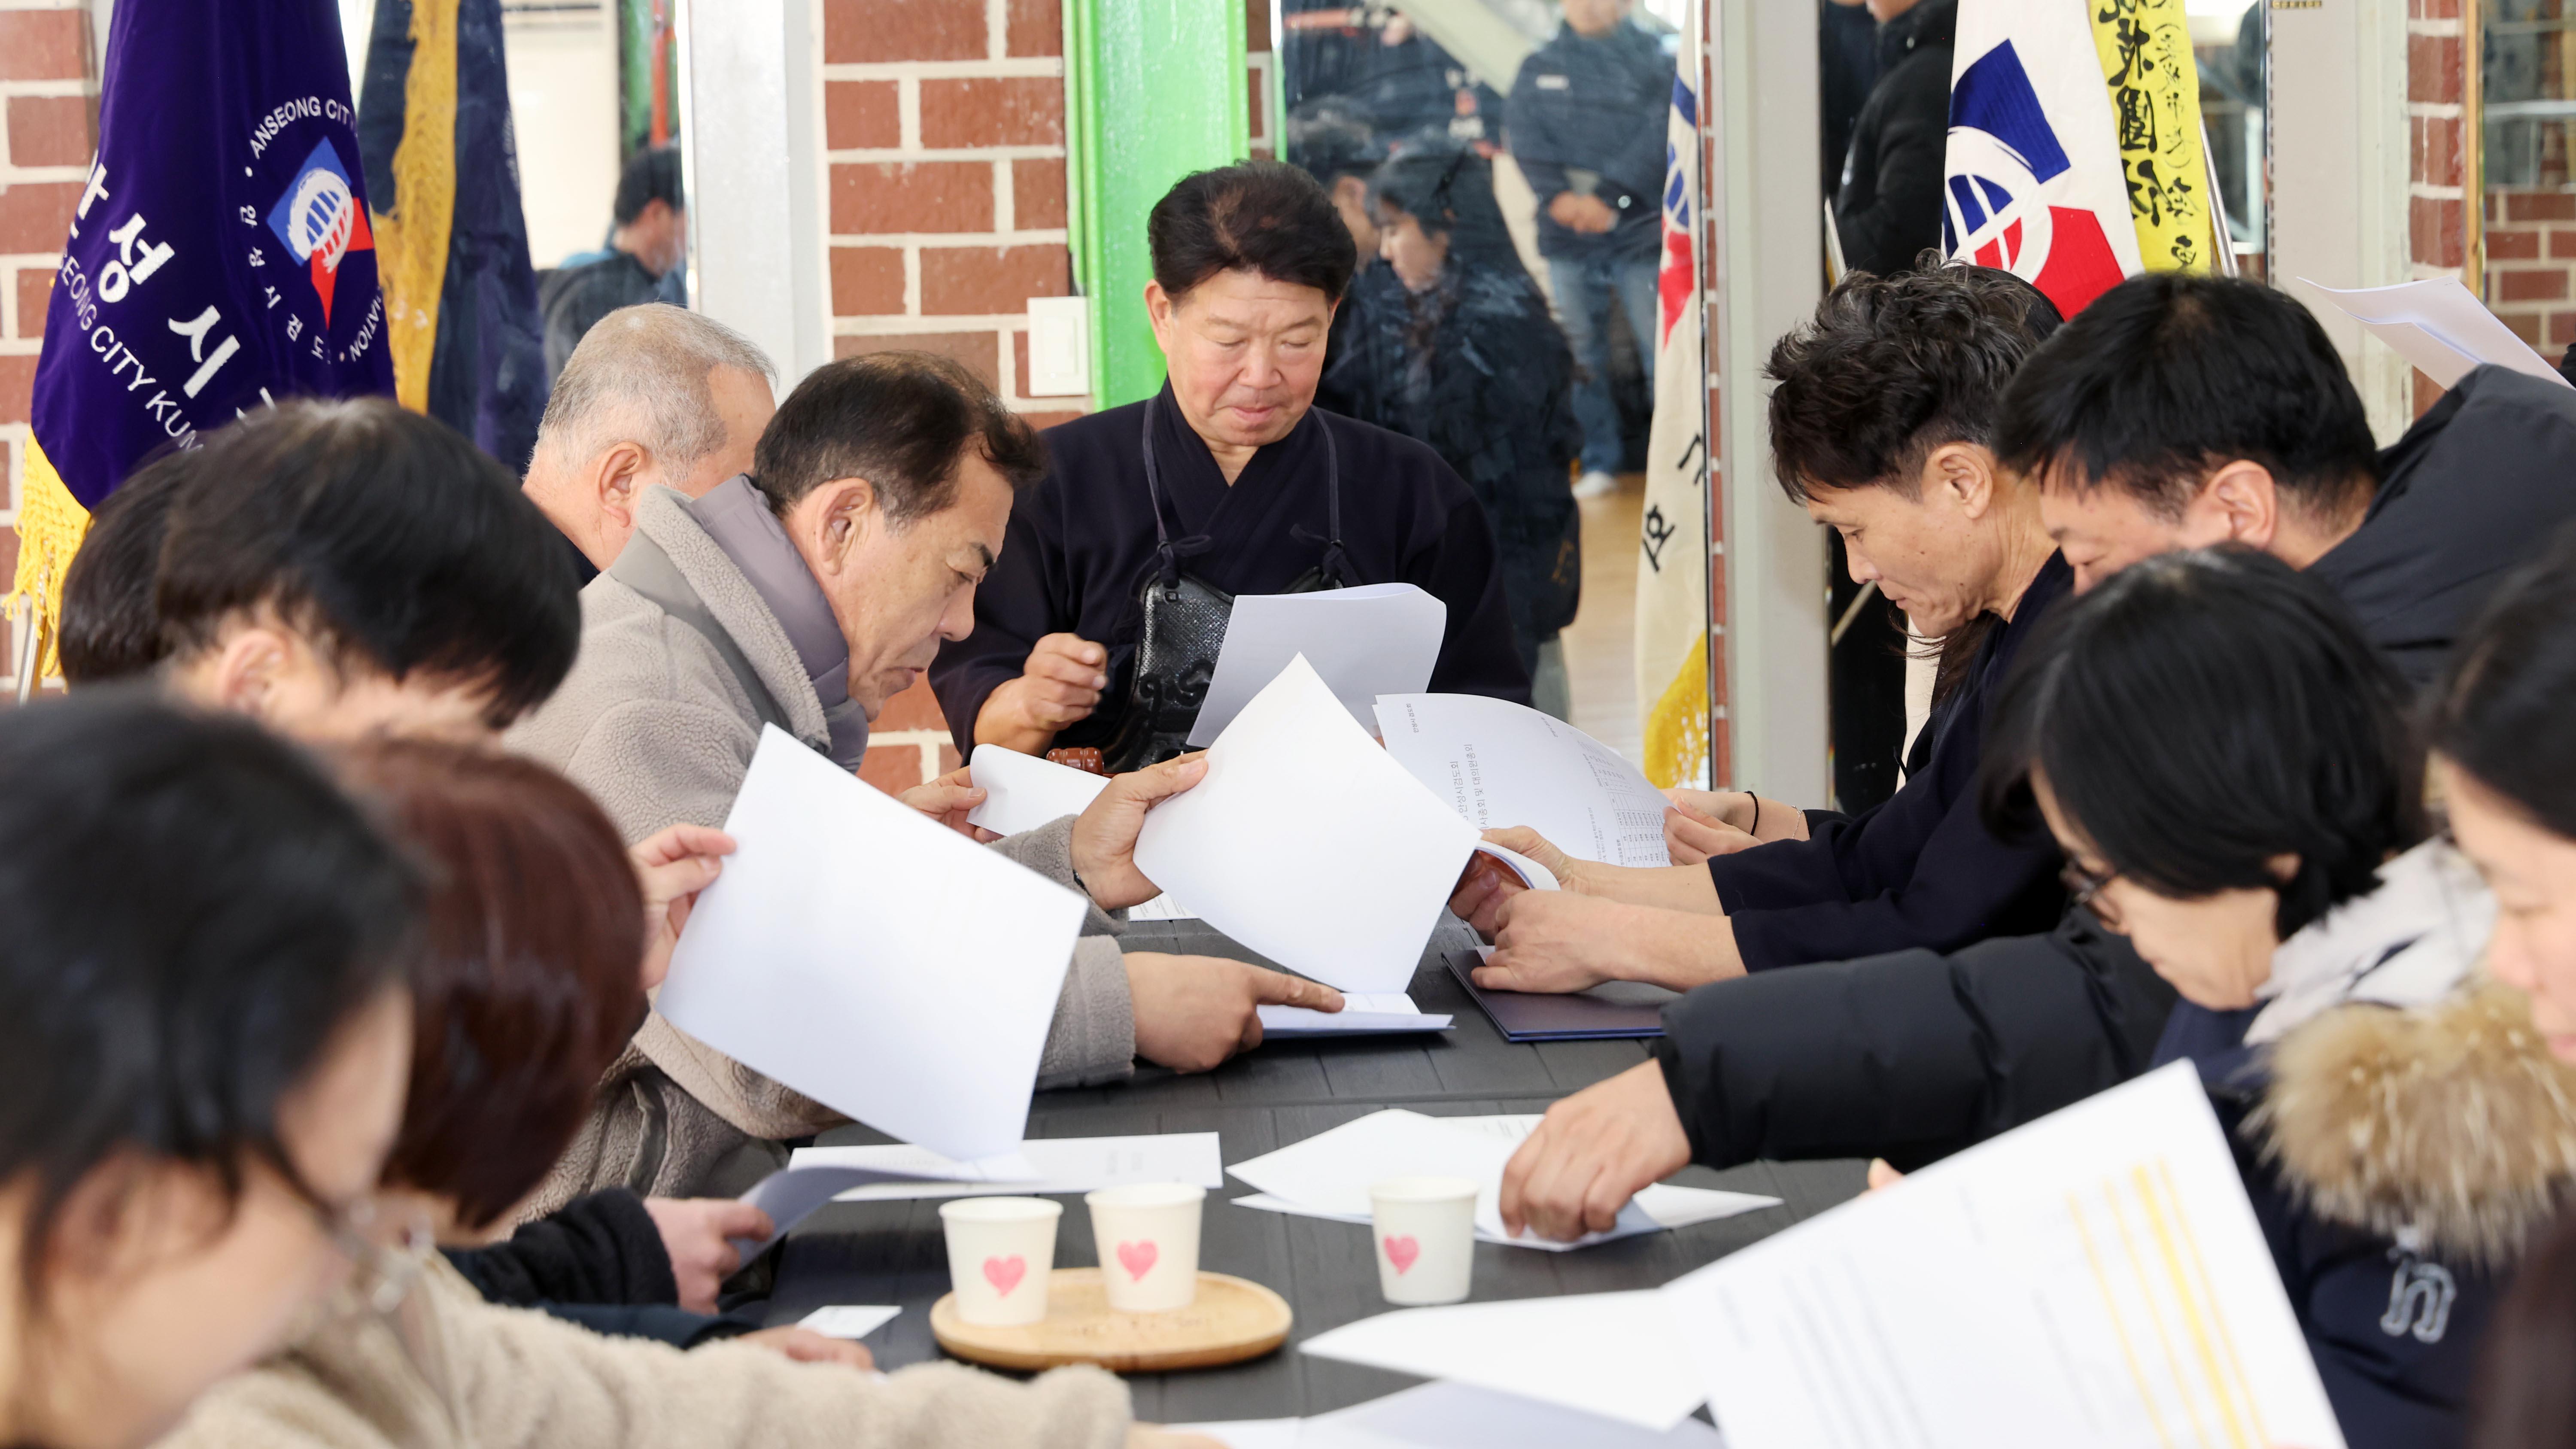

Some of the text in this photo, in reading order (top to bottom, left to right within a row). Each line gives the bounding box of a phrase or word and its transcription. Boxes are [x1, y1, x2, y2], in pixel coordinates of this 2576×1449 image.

[249, 96, 321, 159] ANSEONG
[60, 249, 97, 331] EONG
[91, 325, 157, 392] CITY
[1405, 703, 1419, 733] 안성시 검도회
[1450, 761, 1467, 813] 안성시검도회
[1474, 788, 1484, 796] 및
